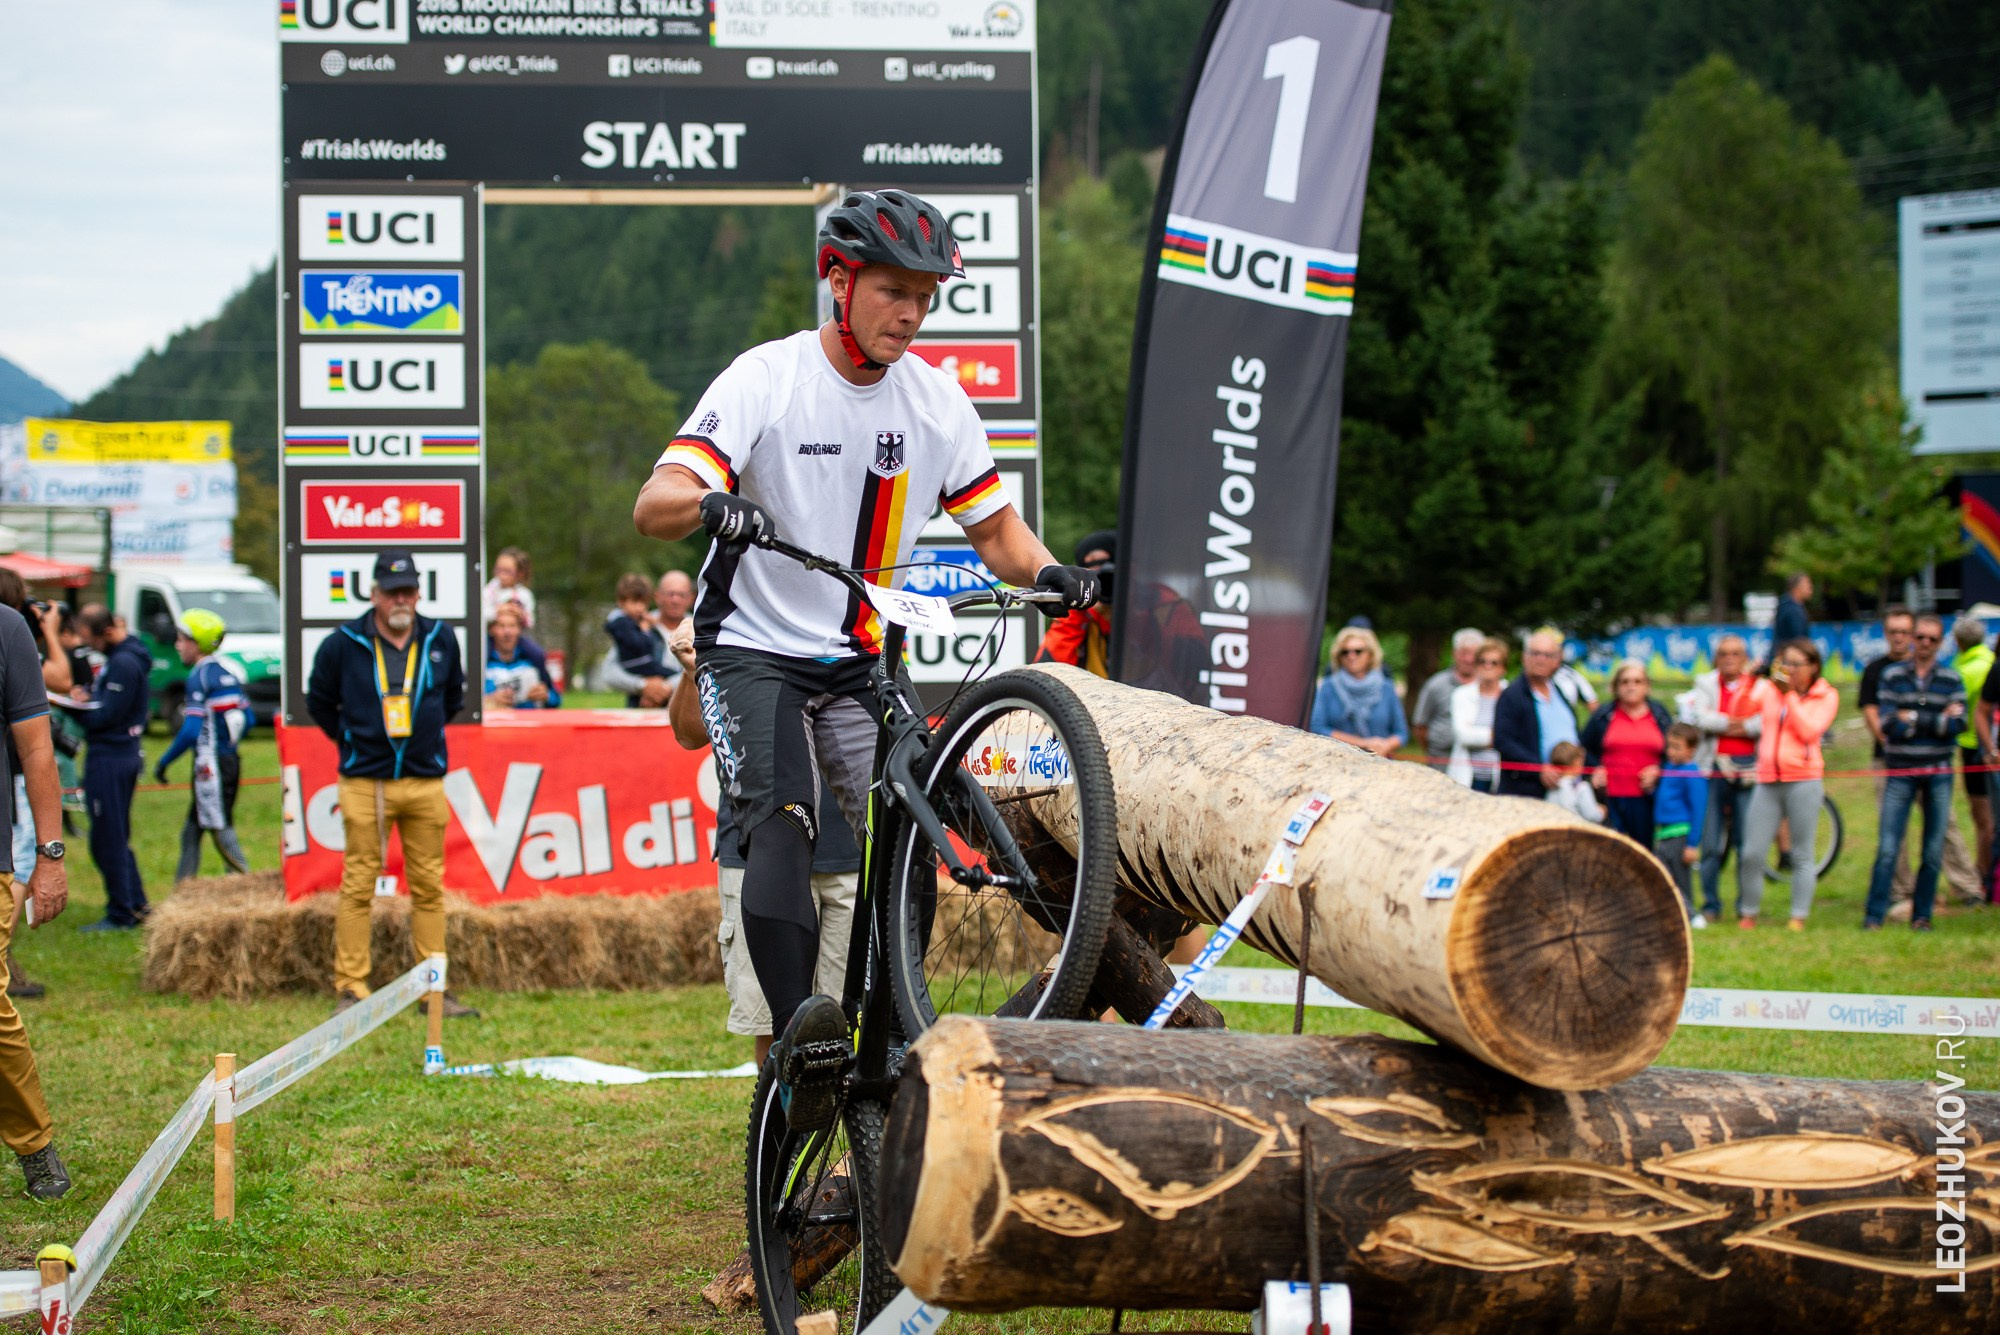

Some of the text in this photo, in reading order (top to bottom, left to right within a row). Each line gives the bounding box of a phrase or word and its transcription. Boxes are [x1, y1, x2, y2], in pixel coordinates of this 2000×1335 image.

[304, 0, 395, 30] UCI
[461, 0, 570, 14] MOUNTAIN
[573, 0, 618, 15] BIKE
[639, 0, 705, 16] TRIALS
[725, 0, 756, 16] VAL
[785, 0, 830, 17] SOLE
[851, 1, 939, 17] TRENTINO
[416, 15, 491, 34] WORLD
[493, 15, 659, 37] CHAMPIONSHIPS
[725, 20, 768, 35] ITALY
[468, 55, 558, 75] @UCI_Trials
[912, 60, 996, 81] uci_cycling
[1262, 34, 1321, 204] 1
[300, 139, 447, 161] #TrialsWorlds
[581, 121, 746, 169] START
[862, 143, 1003, 166] #TrialsWorlds
[349, 212, 435, 244] UCI
[949, 211, 991, 242] CI
[1210, 237, 1293, 294] UCI
[321, 280, 442, 317] TRENTINO
[349, 360, 436, 391] UCI
[354, 435, 411, 456] UCI
[322, 495, 365, 529] Val
[1200, 354, 1267, 713] rialsWorlds
[351, 570, 437, 602] UI
[914, 634, 997, 666] UCI
[1029, 745, 1070, 779] TRENT
[443, 762, 612, 893] Val
[623, 797, 698, 869] di
